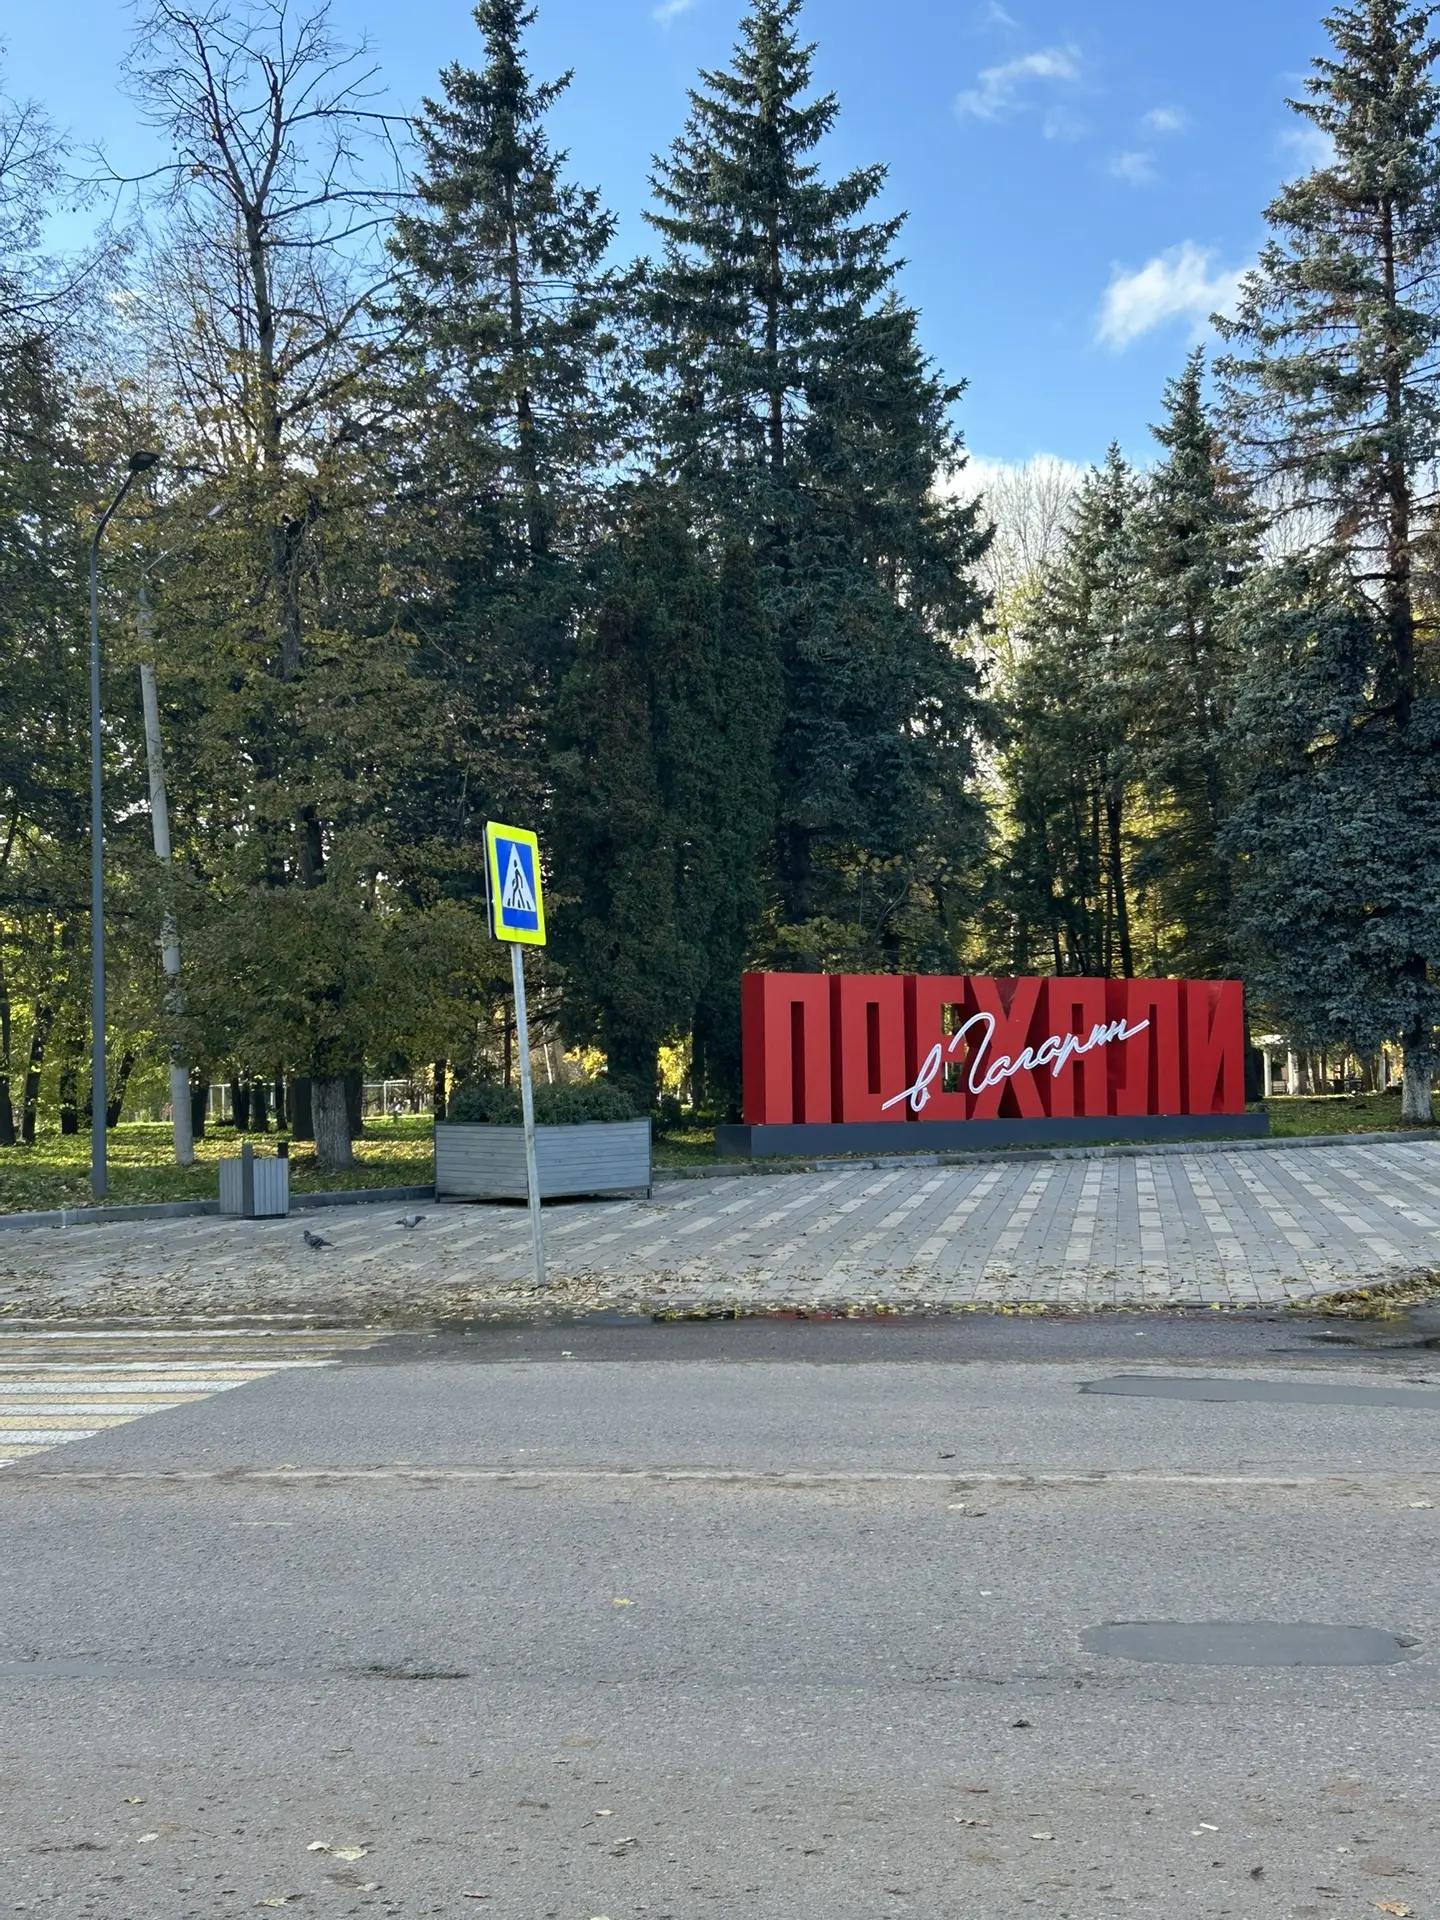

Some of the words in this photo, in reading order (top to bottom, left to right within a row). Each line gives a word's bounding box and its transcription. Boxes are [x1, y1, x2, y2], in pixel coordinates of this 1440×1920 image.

[745, 973, 1245, 1124] ПОЕХАЛИ
[881, 1043, 942, 1112] в
[947, 1011, 1150, 1095] Гагарин
